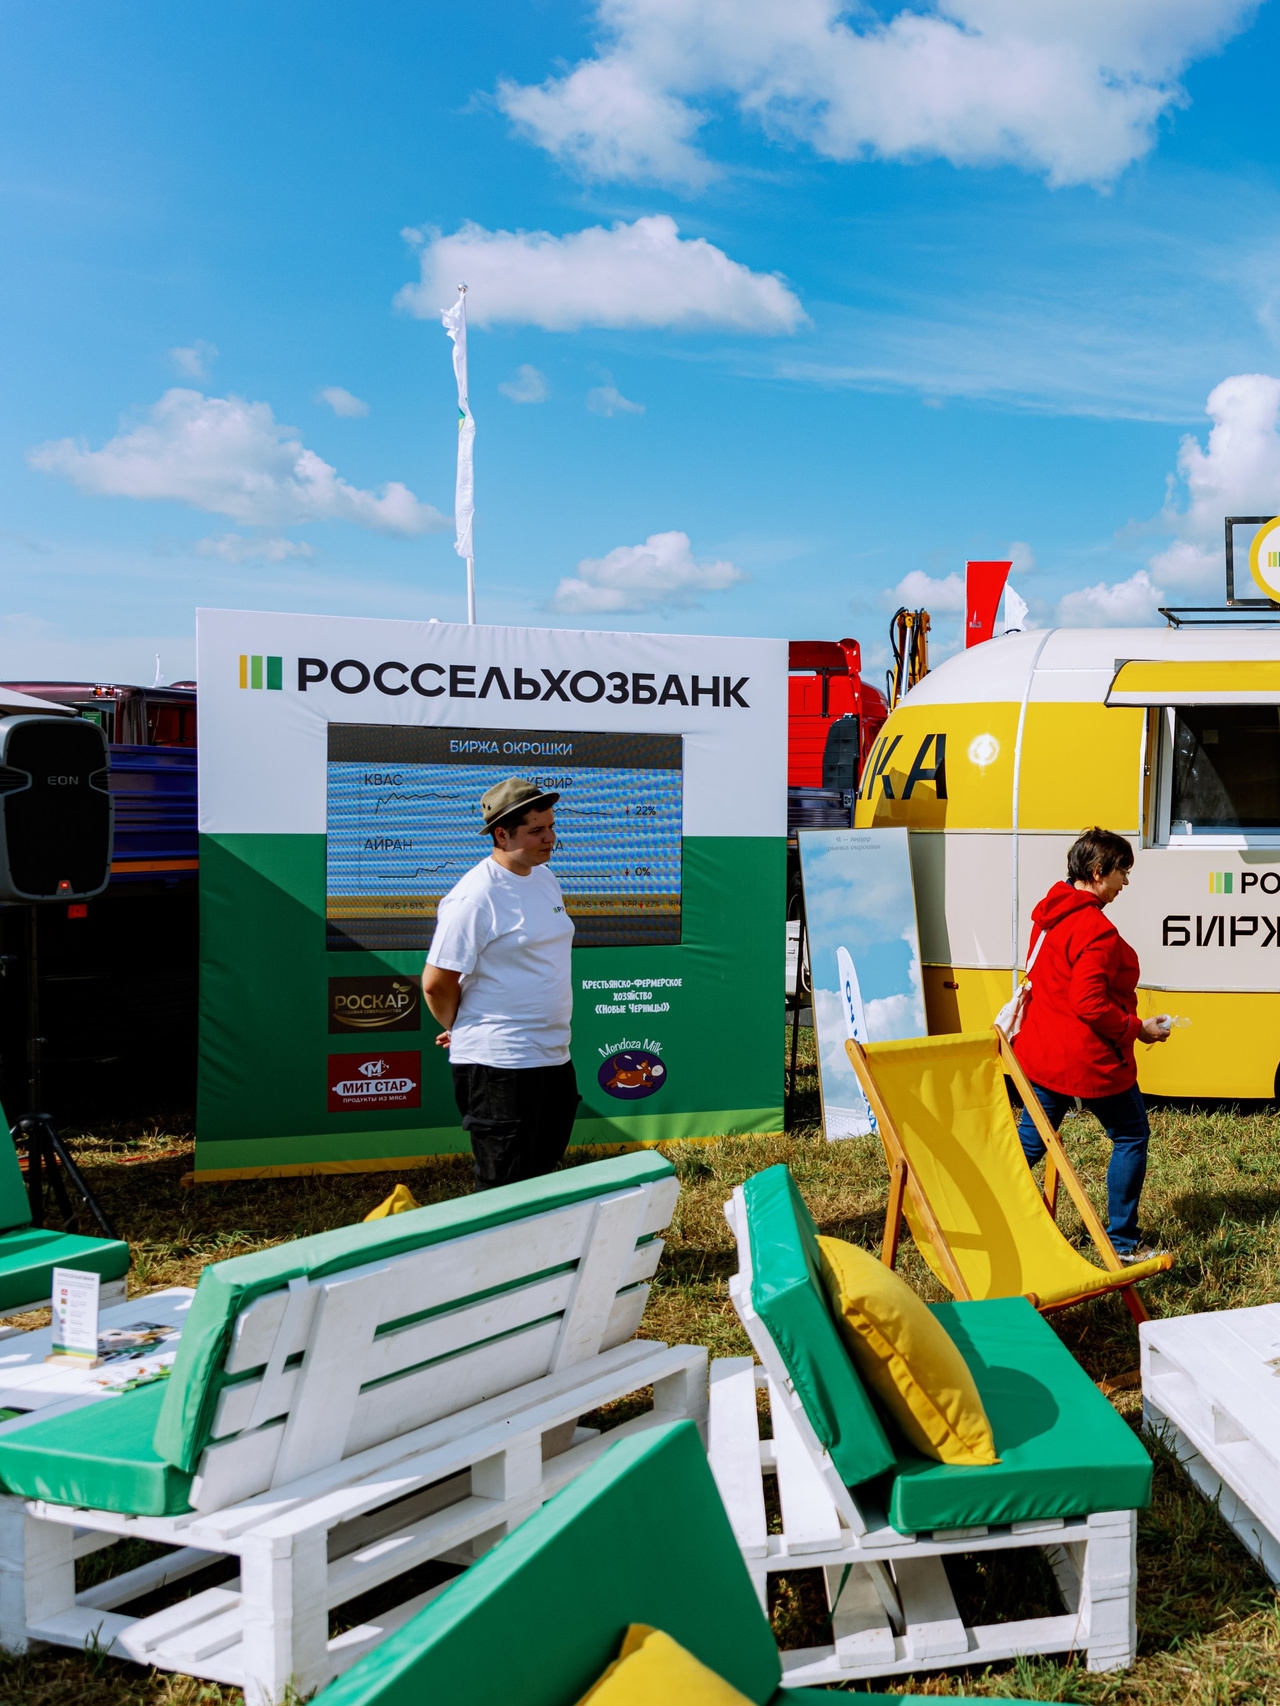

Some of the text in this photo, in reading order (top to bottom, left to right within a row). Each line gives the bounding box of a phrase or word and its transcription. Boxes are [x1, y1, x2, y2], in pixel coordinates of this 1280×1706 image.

[297, 657, 751, 709] РОССЕЛЬХОЗБАНК
[450, 740, 573, 755] БИРЖА ОКРОШКИ
[47, 776, 79, 785] EON
[364, 774, 403, 786] КВАС
[635, 805, 656, 815] 22%
[363, 836, 413, 851] АЙРАН
[635, 867, 651, 876] 0%
[334, 994, 409, 1010] РОСКАР
[598, 1038, 663, 1057] Mendoza Milk
[342, 1081, 408, 1093] МИТ СТАР
